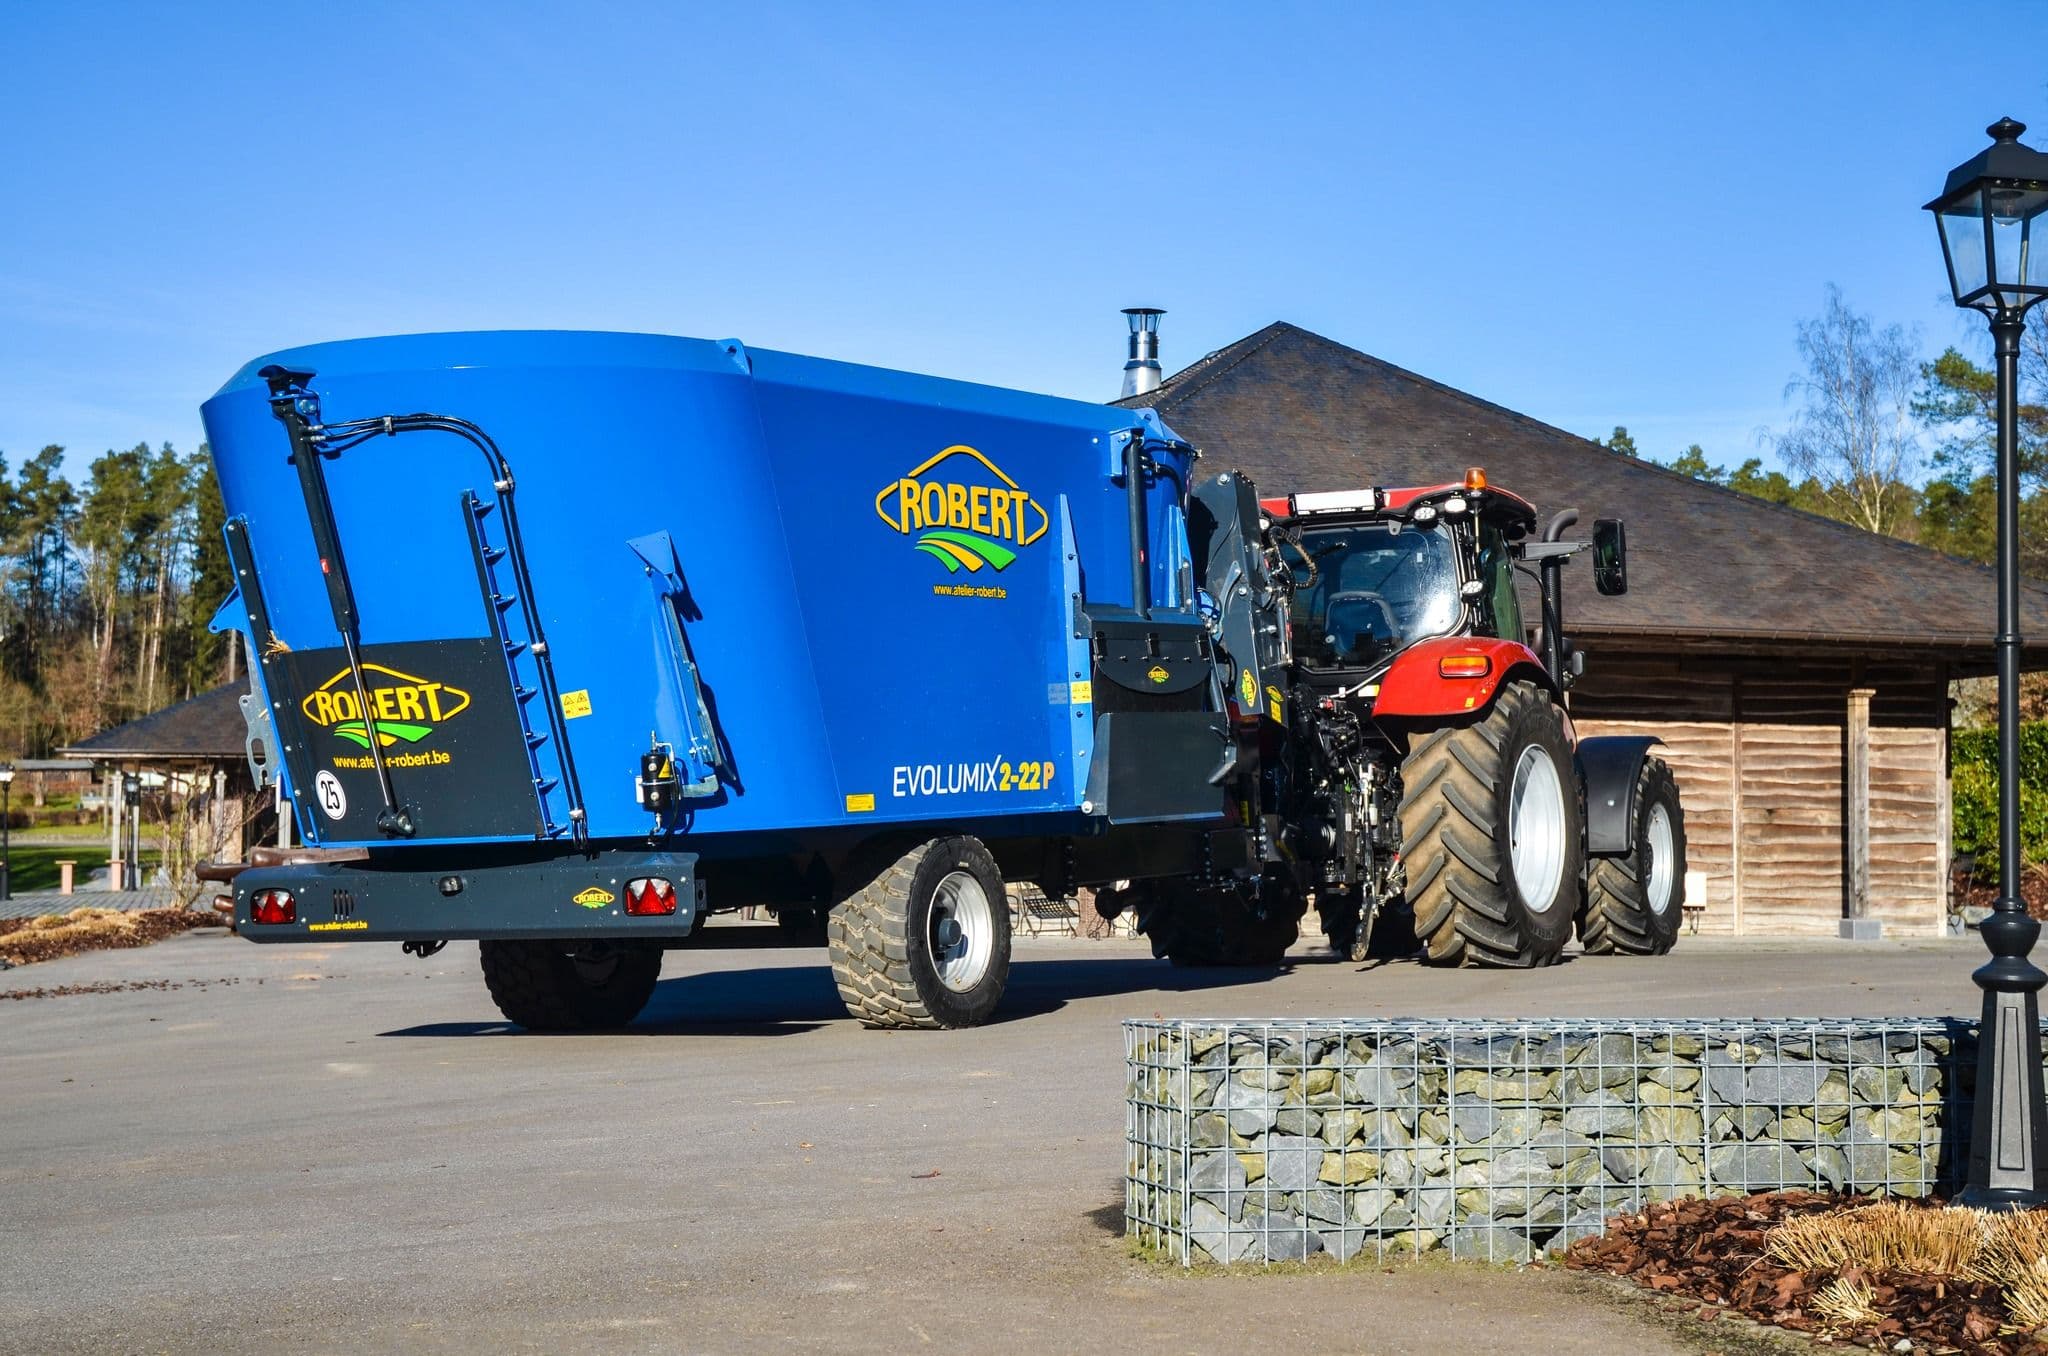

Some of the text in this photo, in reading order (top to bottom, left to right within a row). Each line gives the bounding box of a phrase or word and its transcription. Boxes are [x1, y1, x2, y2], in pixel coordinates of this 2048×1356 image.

[899, 478, 1029, 546] ROBERT
[933, 584, 1007, 599] www.atelier-robert.be
[333, 750, 451, 769] www.ater-robert.be
[893, 754, 1002, 797] EVOLUMIX
[320, 780, 341, 810] 25
[578, 893, 609, 904] ROBERT
